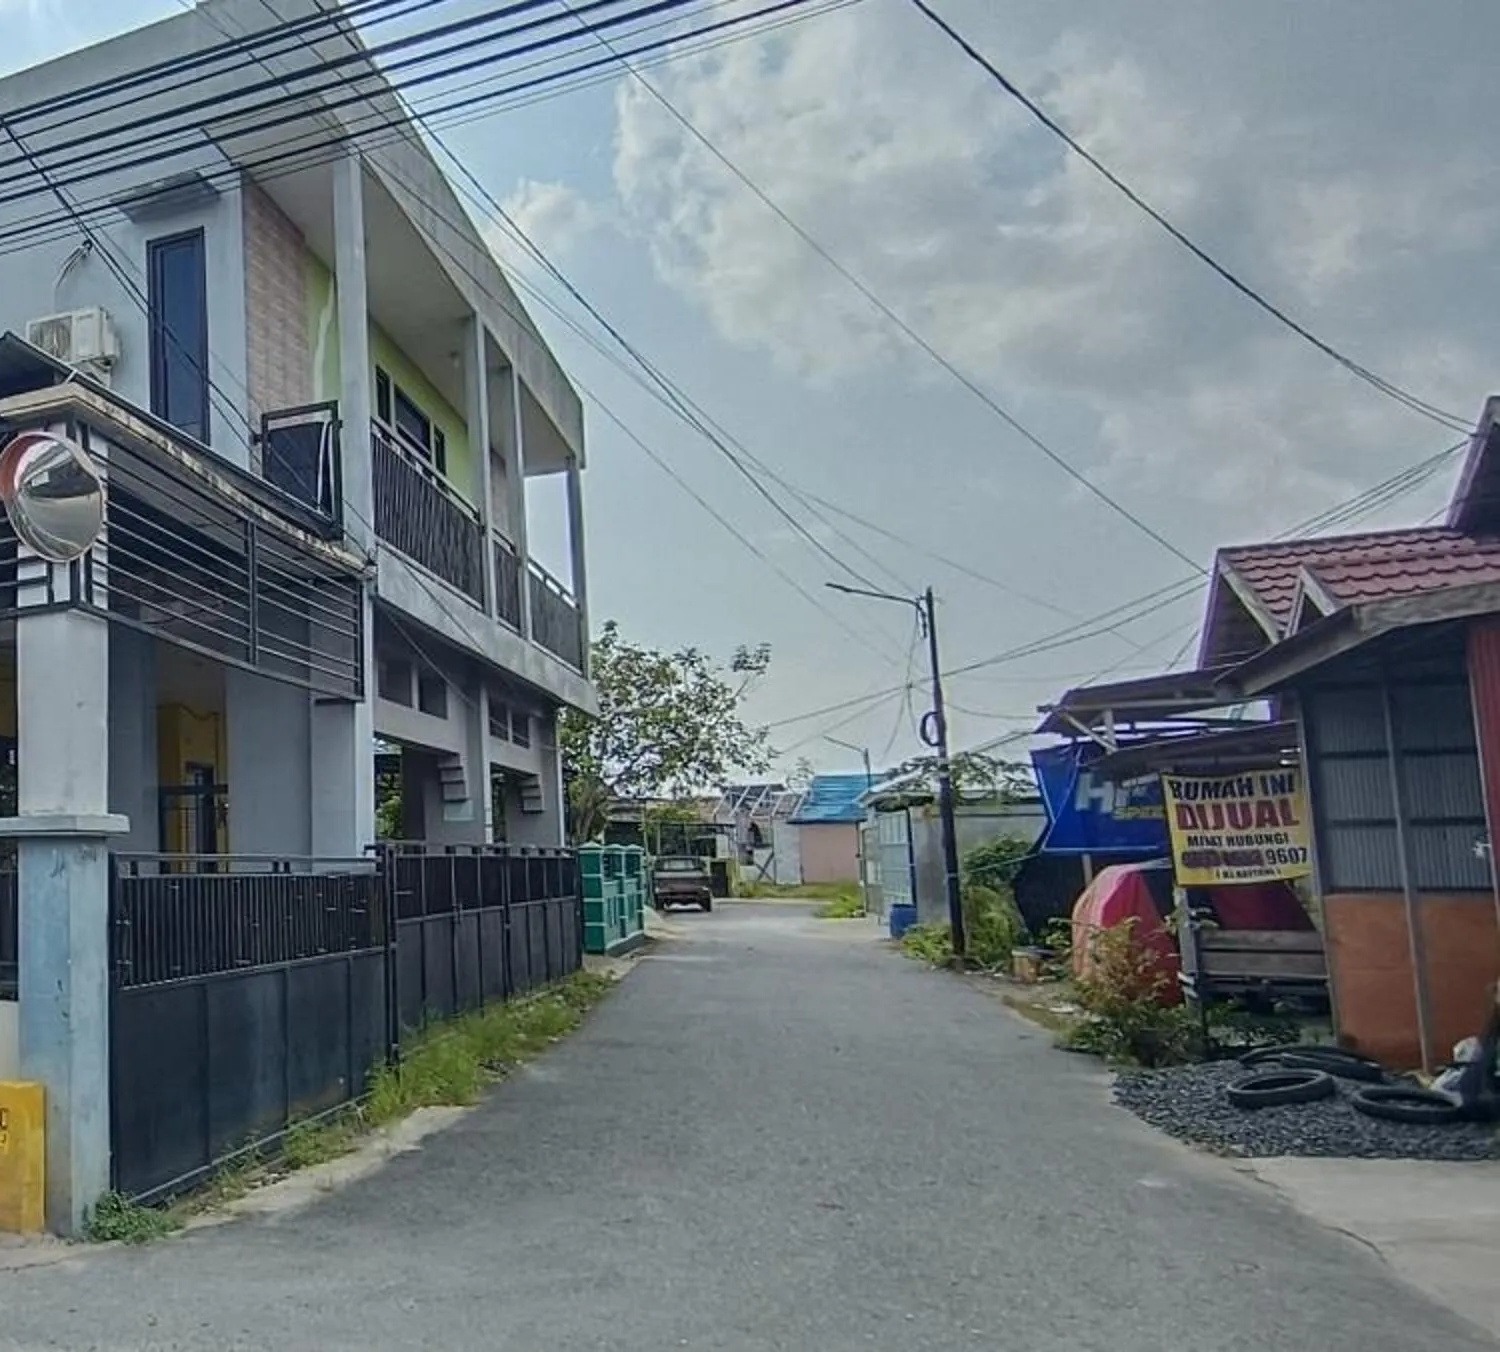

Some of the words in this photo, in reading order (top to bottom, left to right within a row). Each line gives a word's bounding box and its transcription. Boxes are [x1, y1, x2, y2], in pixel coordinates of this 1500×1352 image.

[1168, 777, 1254, 800] RUMAH
[1260, 772, 1295, 796] INI
[1175, 798, 1300, 831] DIJUAL
[1225, 832, 1289, 847] HUBUNGI
[1265, 847, 1307, 866] 9607
